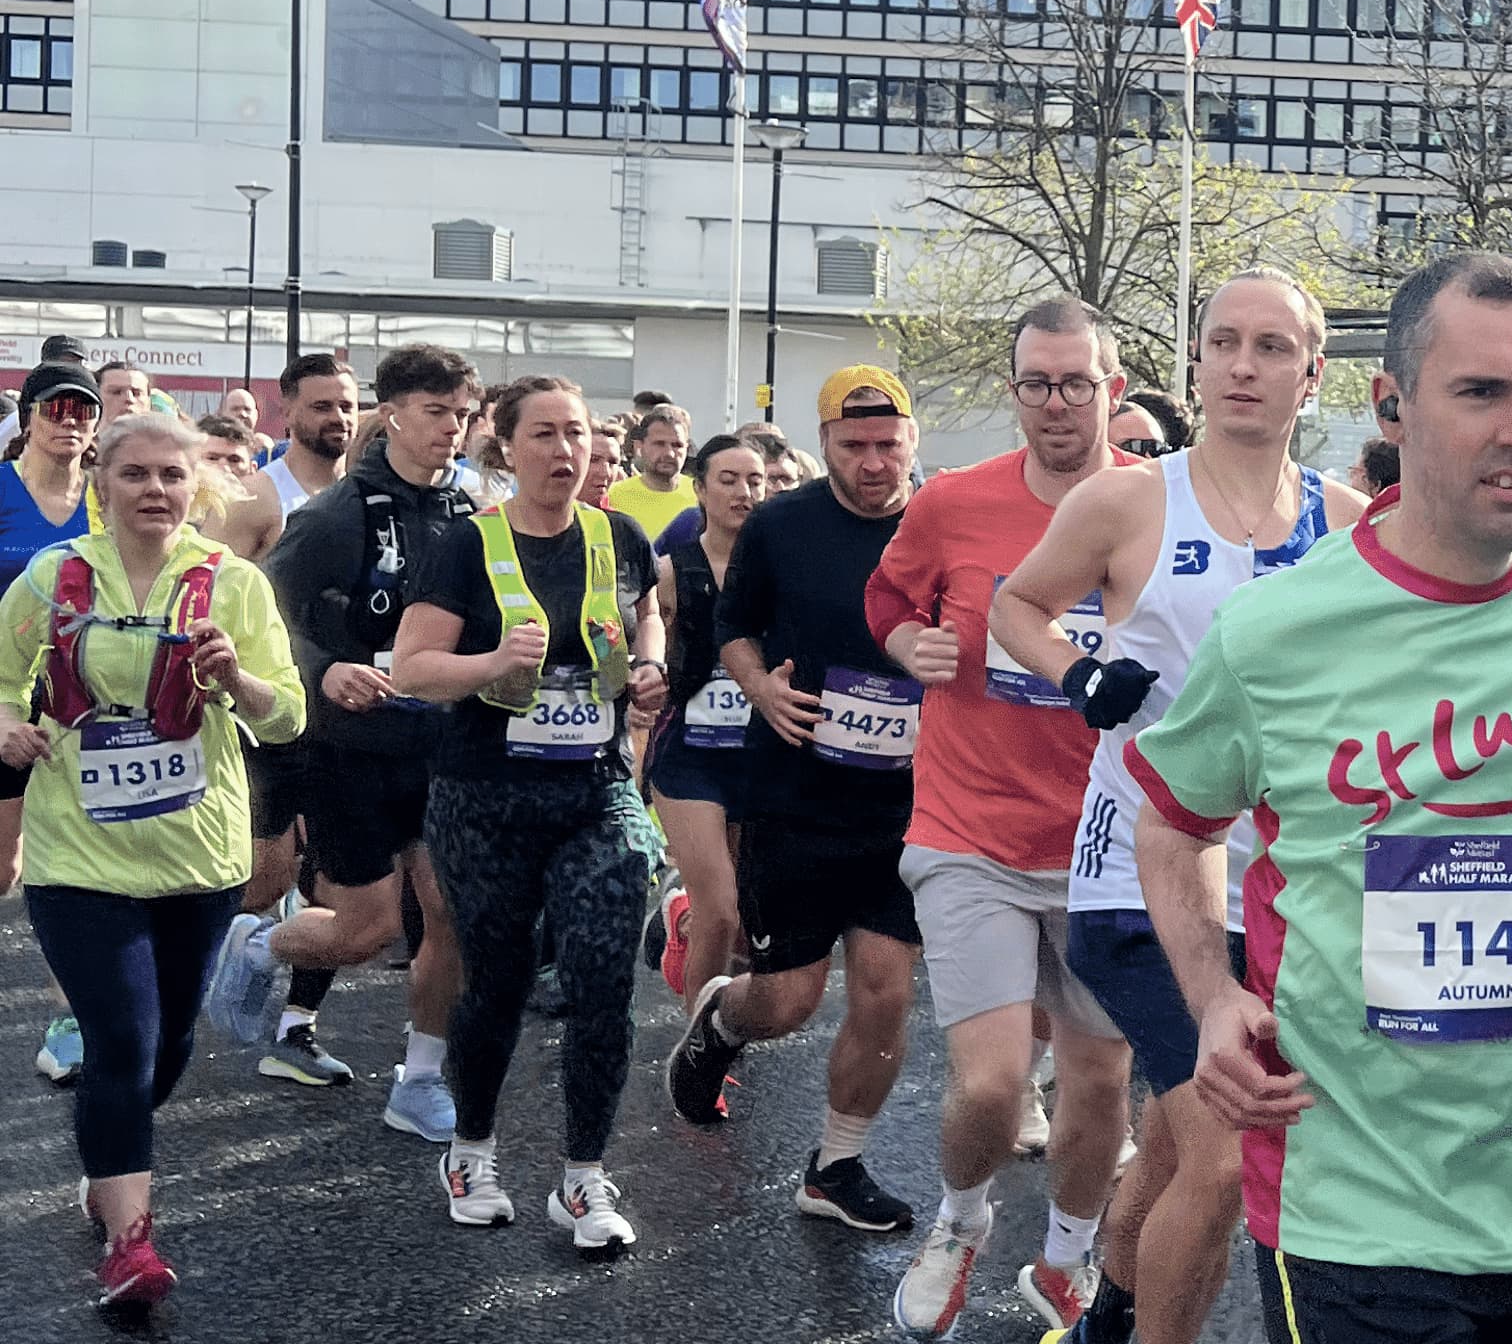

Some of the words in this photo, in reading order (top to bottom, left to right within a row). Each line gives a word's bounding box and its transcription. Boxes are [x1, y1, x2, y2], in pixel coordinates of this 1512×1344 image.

[124, 346, 205, 367] Connect
[707, 691, 748, 710] 139
[532, 702, 601, 726] 3668
[837, 710, 907, 738] 4473
[108, 753, 186, 786] 1318
[1450, 861, 1506, 873] SHEFFIELD
[1449, 872, 1478, 885] HALF
